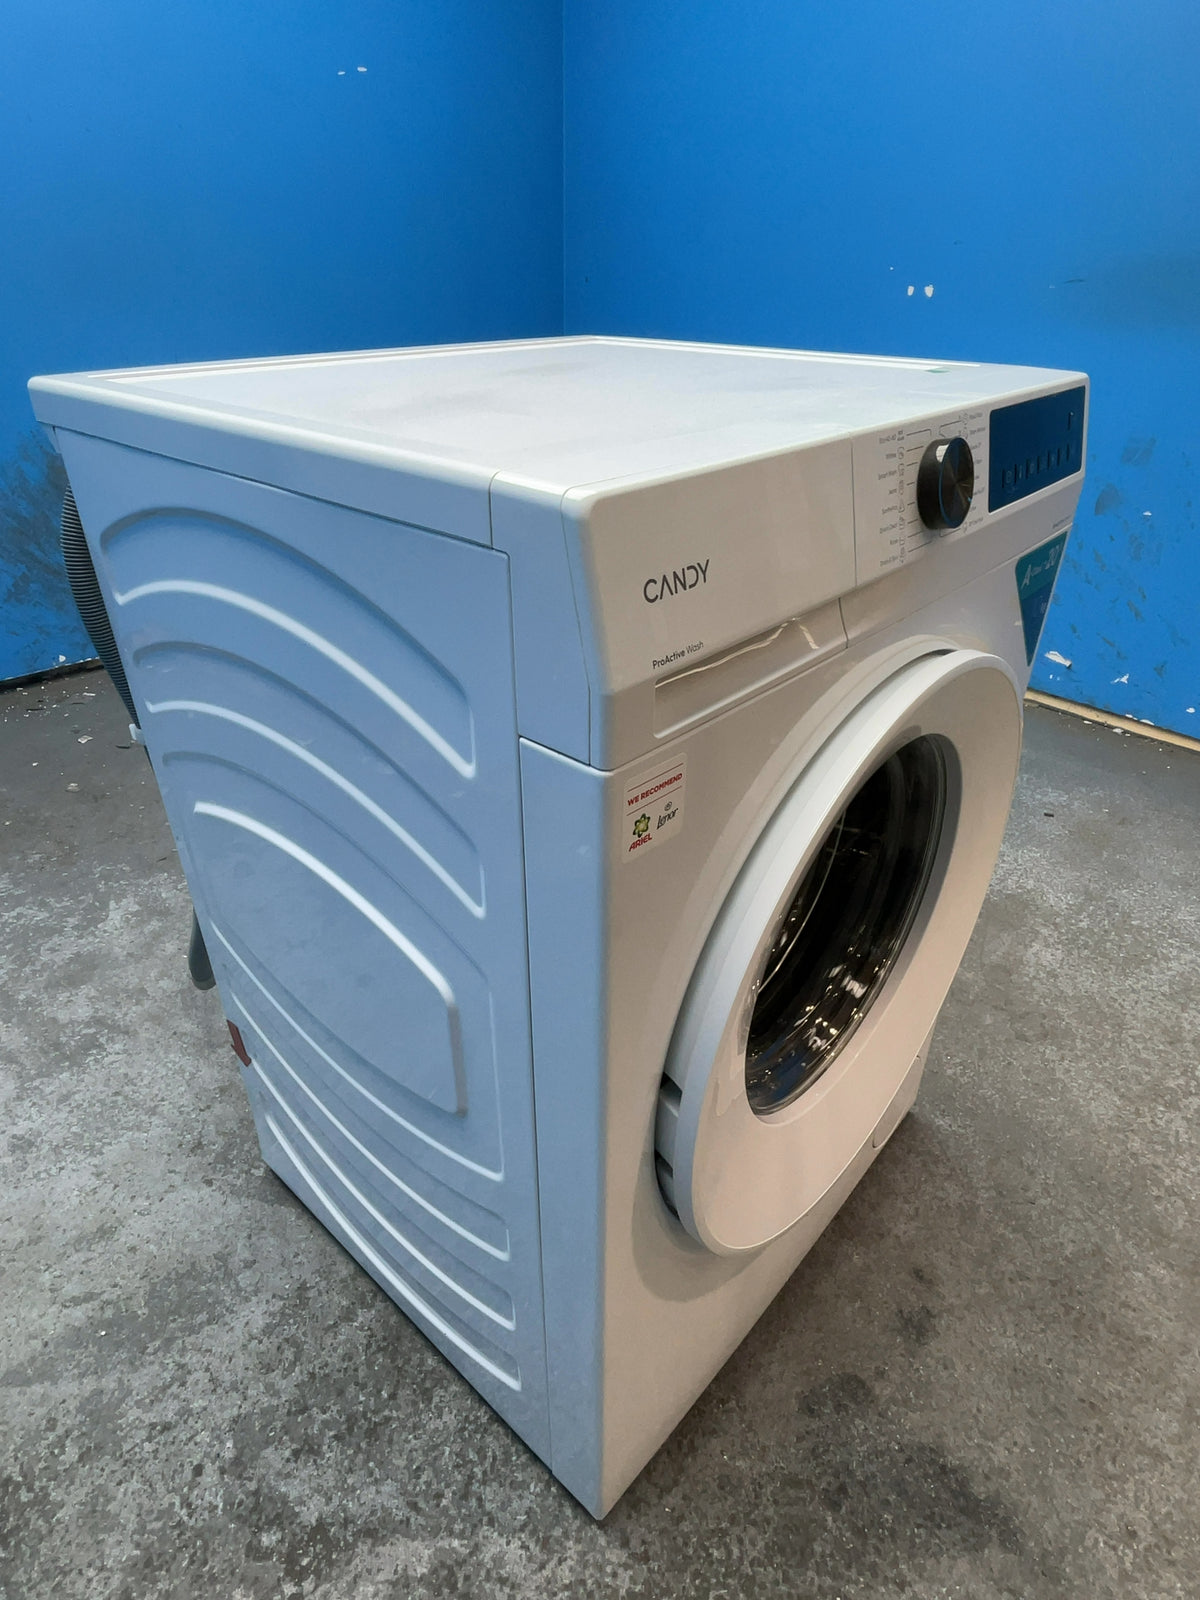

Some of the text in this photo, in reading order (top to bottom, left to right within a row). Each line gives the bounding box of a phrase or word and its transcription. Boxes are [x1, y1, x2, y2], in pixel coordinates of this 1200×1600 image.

[643, 559, 710, 604] CANDY
[652, 640, 704, 669] ProActive Wash
[627, 772, 683, 806] WE RECOMMEND
[628, 833, 653, 852] ARIEL
